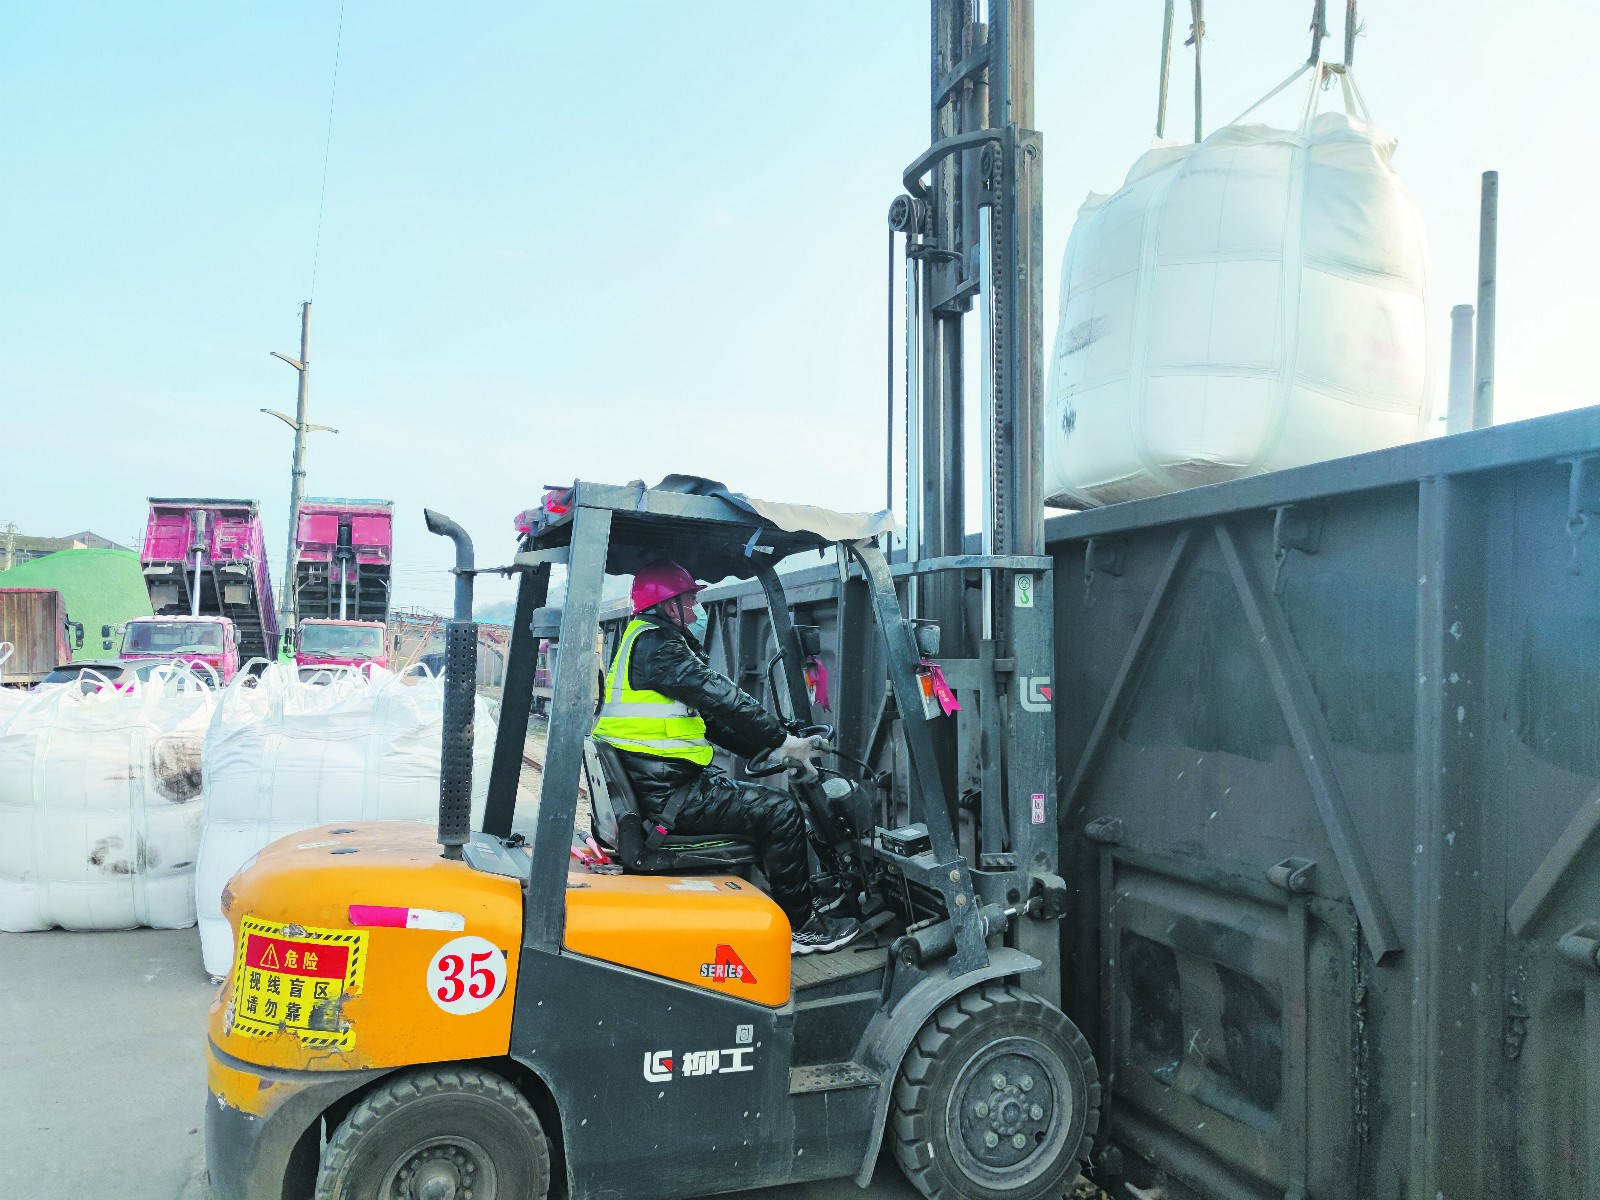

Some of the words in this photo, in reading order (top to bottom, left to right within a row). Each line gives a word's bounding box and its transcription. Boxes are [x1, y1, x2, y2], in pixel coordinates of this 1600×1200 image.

[284, 949, 319, 970] 危险
[700, 964, 744, 977] SERIES
[249, 971, 331, 1000] 视线盲区
[437, 950, 496, 1003] 35
[246, 995, 332, 1025] 请勿靠
[682, 1047, 753, 1077] 柳工
